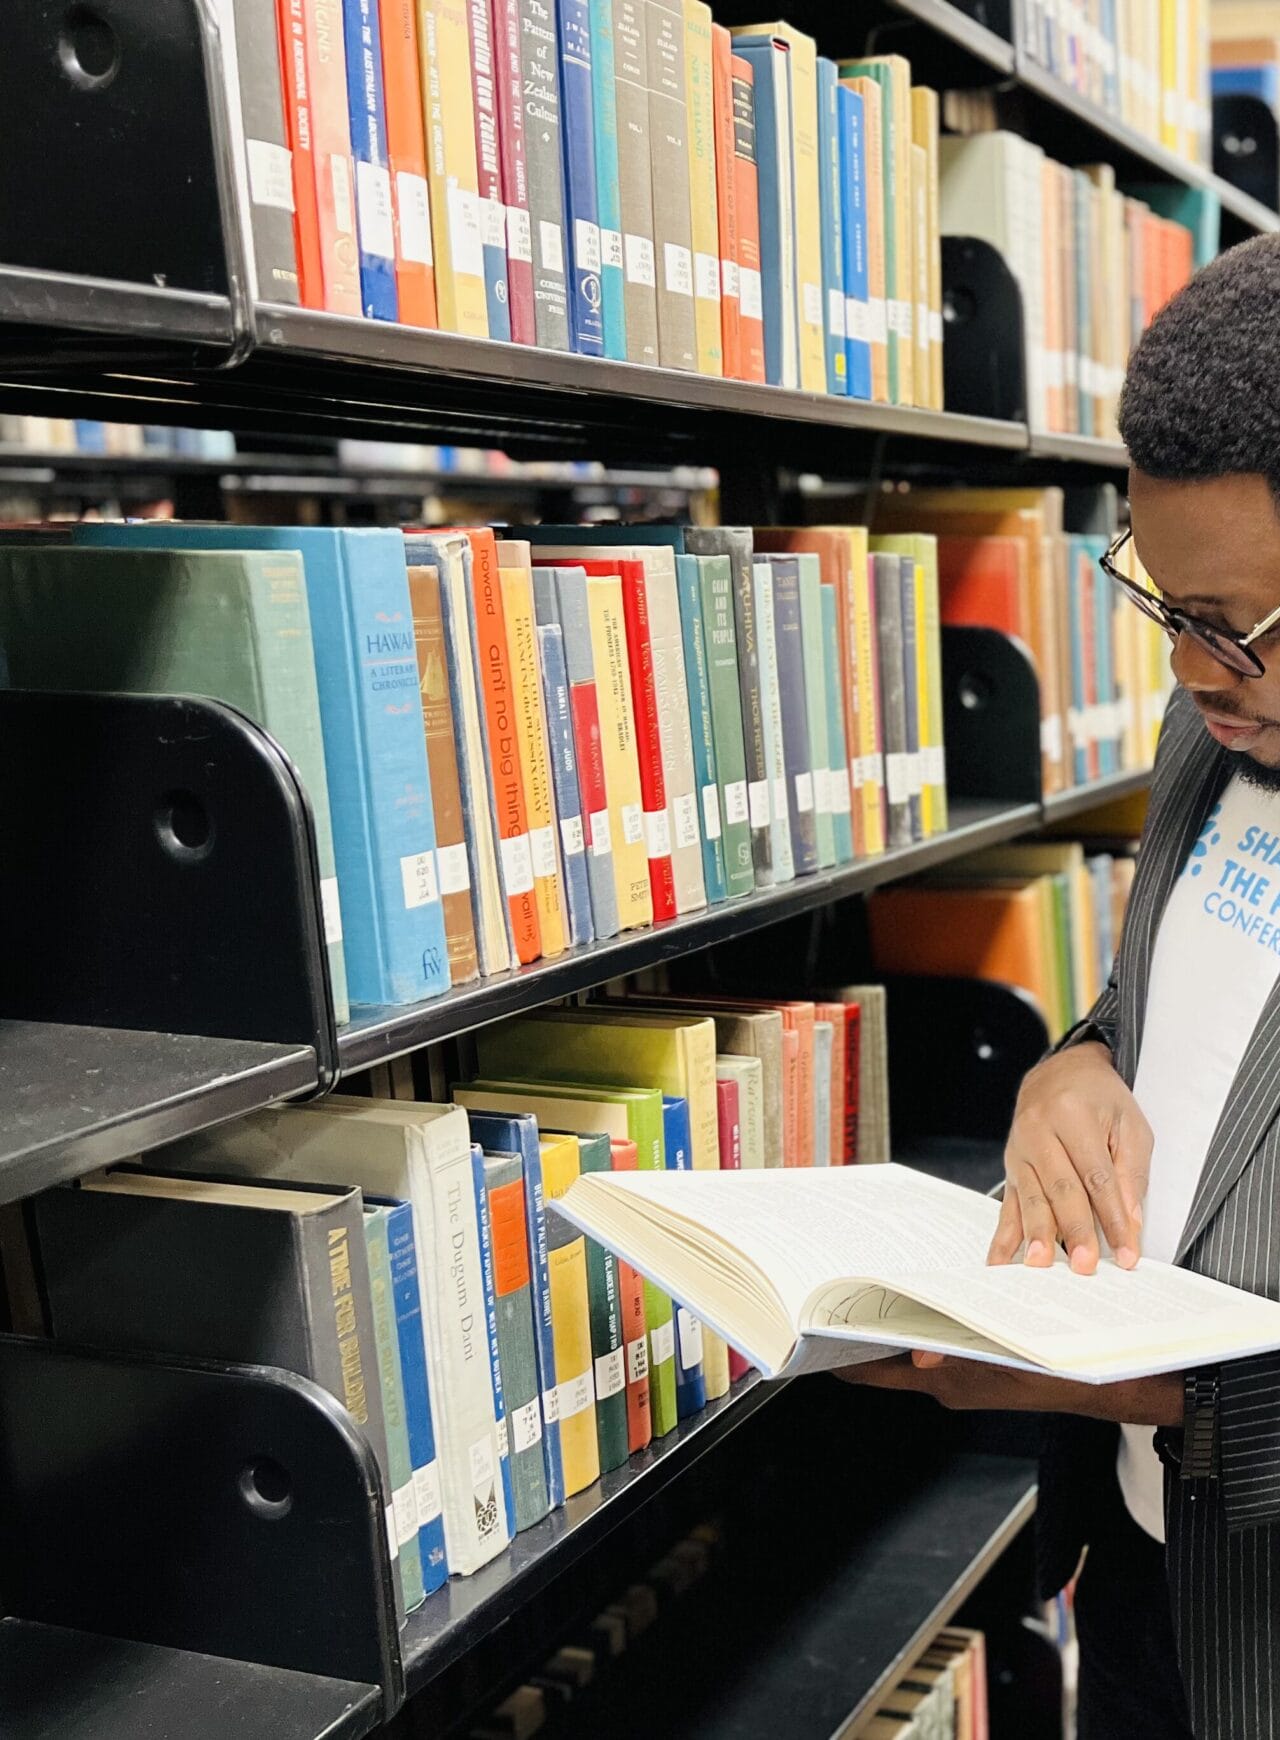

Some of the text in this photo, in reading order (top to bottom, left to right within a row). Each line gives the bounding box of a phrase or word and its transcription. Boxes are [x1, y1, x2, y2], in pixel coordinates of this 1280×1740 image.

[529, 0, 549, 20] The
[530, 60, 555, 81] New
[536, 45, 549, 59] of
[364, 47, 377, 112] AUSTRALIAN
[479, 111, 499, 173] Zealand
[712, 628, 735, 645] PEOPLE
[480, 549, 522, 838] howard ain't no big thing
[1217, 858, 1271, 906] THE
[328, 1227, 348, 1246] A
[329, 1239, 352, 1297] TIME
[447, 1181, 474, 1361] The Dugum Dani
[334, 1292, 357, 1339] FOR
[605, 1255, 619, 1350] ISLANDERS SHAPIRO
